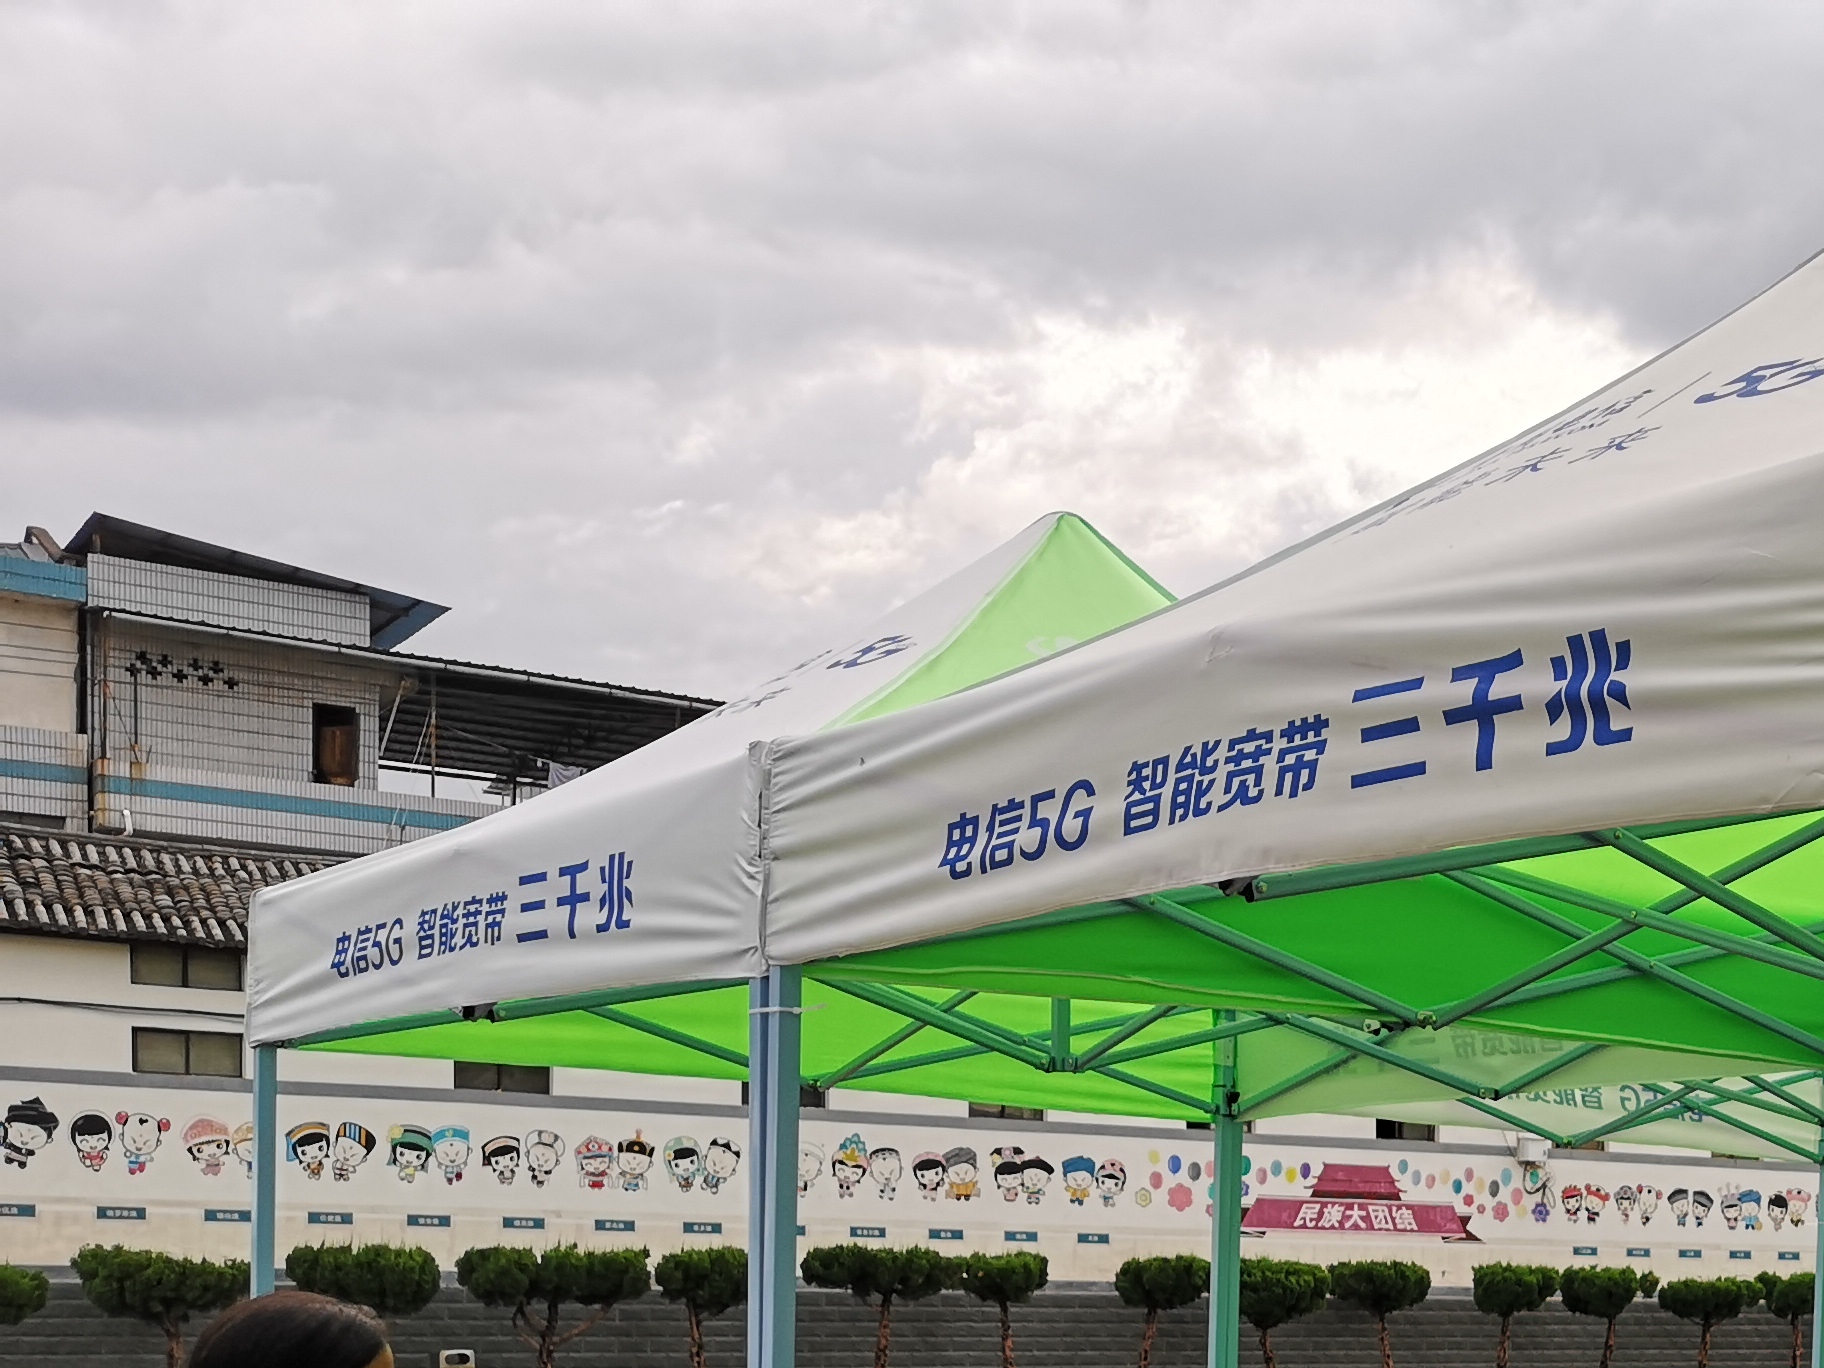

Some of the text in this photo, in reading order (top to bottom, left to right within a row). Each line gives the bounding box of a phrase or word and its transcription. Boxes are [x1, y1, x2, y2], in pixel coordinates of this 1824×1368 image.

[938, 627, 1634, 881] 电信5G 智能宽带 三千兆
[331, 851, 634, 979] 电信5G 智能宽带 三千兆
[1293, 1203, 1418, 1231] 民族大团结
